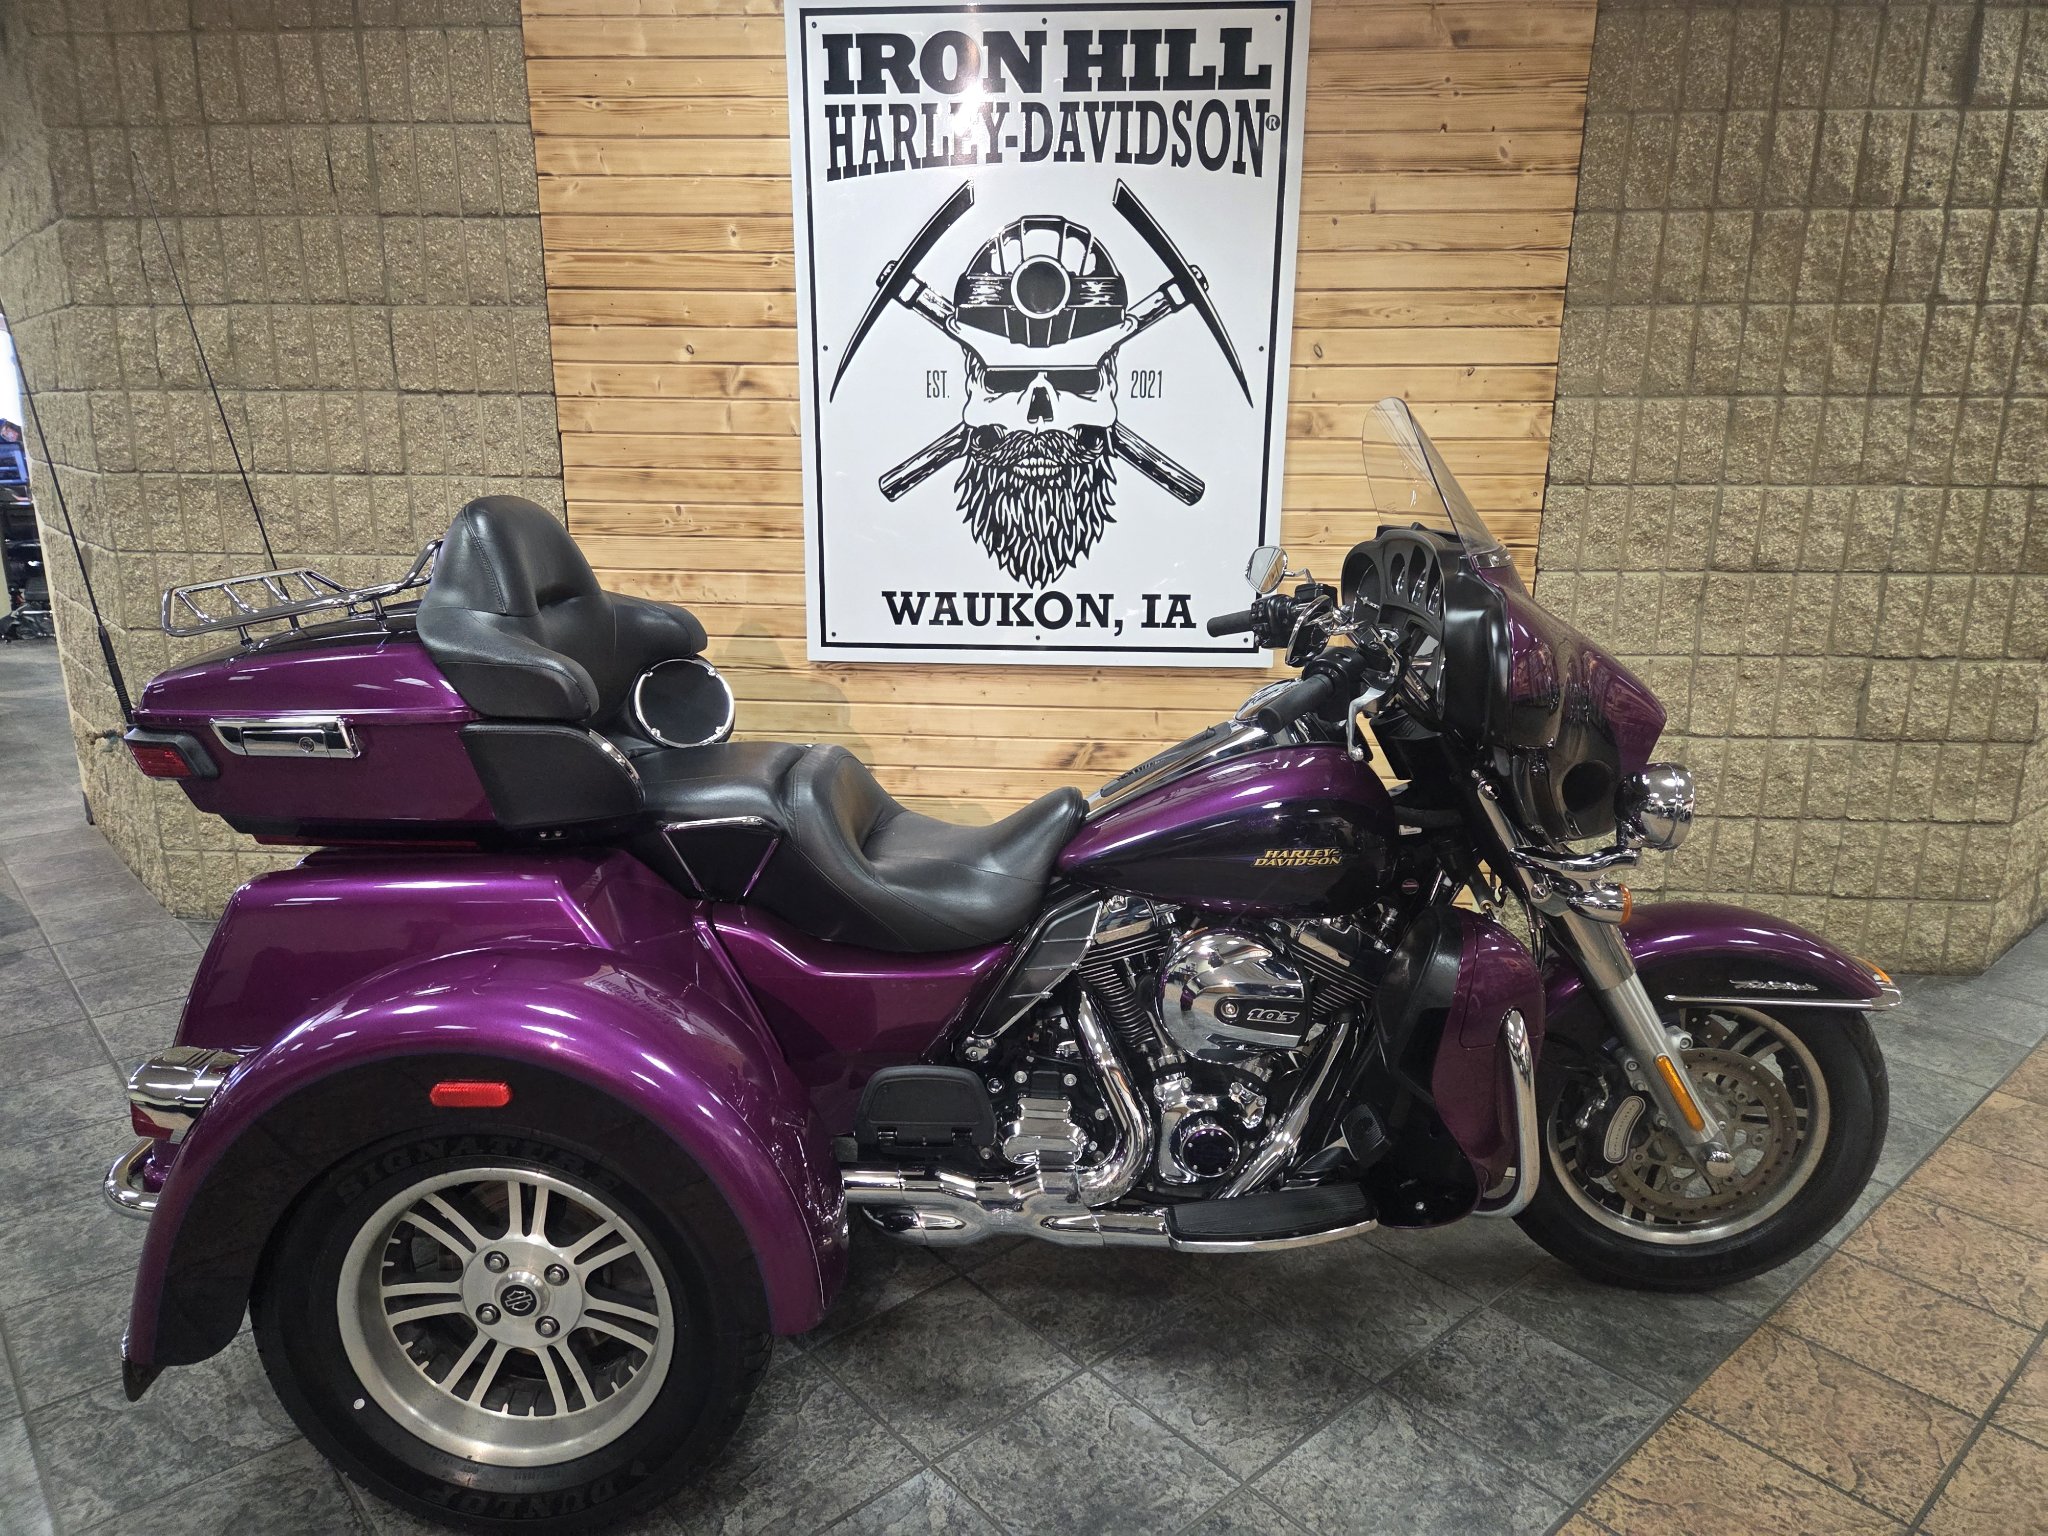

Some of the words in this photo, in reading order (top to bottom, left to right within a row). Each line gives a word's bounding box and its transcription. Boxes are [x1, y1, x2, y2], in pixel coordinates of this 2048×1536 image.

[822, 29, 1048, 95] IRON
[1063, 27, 1273, 92] HILL
[926, 370, 950, 399] EST.
[1130, 370, 1163, 399] 2021
[882, 590, 1123, 637] WAUKON,
[1141, 594, 1197, 629] IA
[1253, 857, 1342, 867] DAVIDSON
[1247, 1008, 1299, 1024] 103
[422, 1479, 614, 1518] DUNLOP
